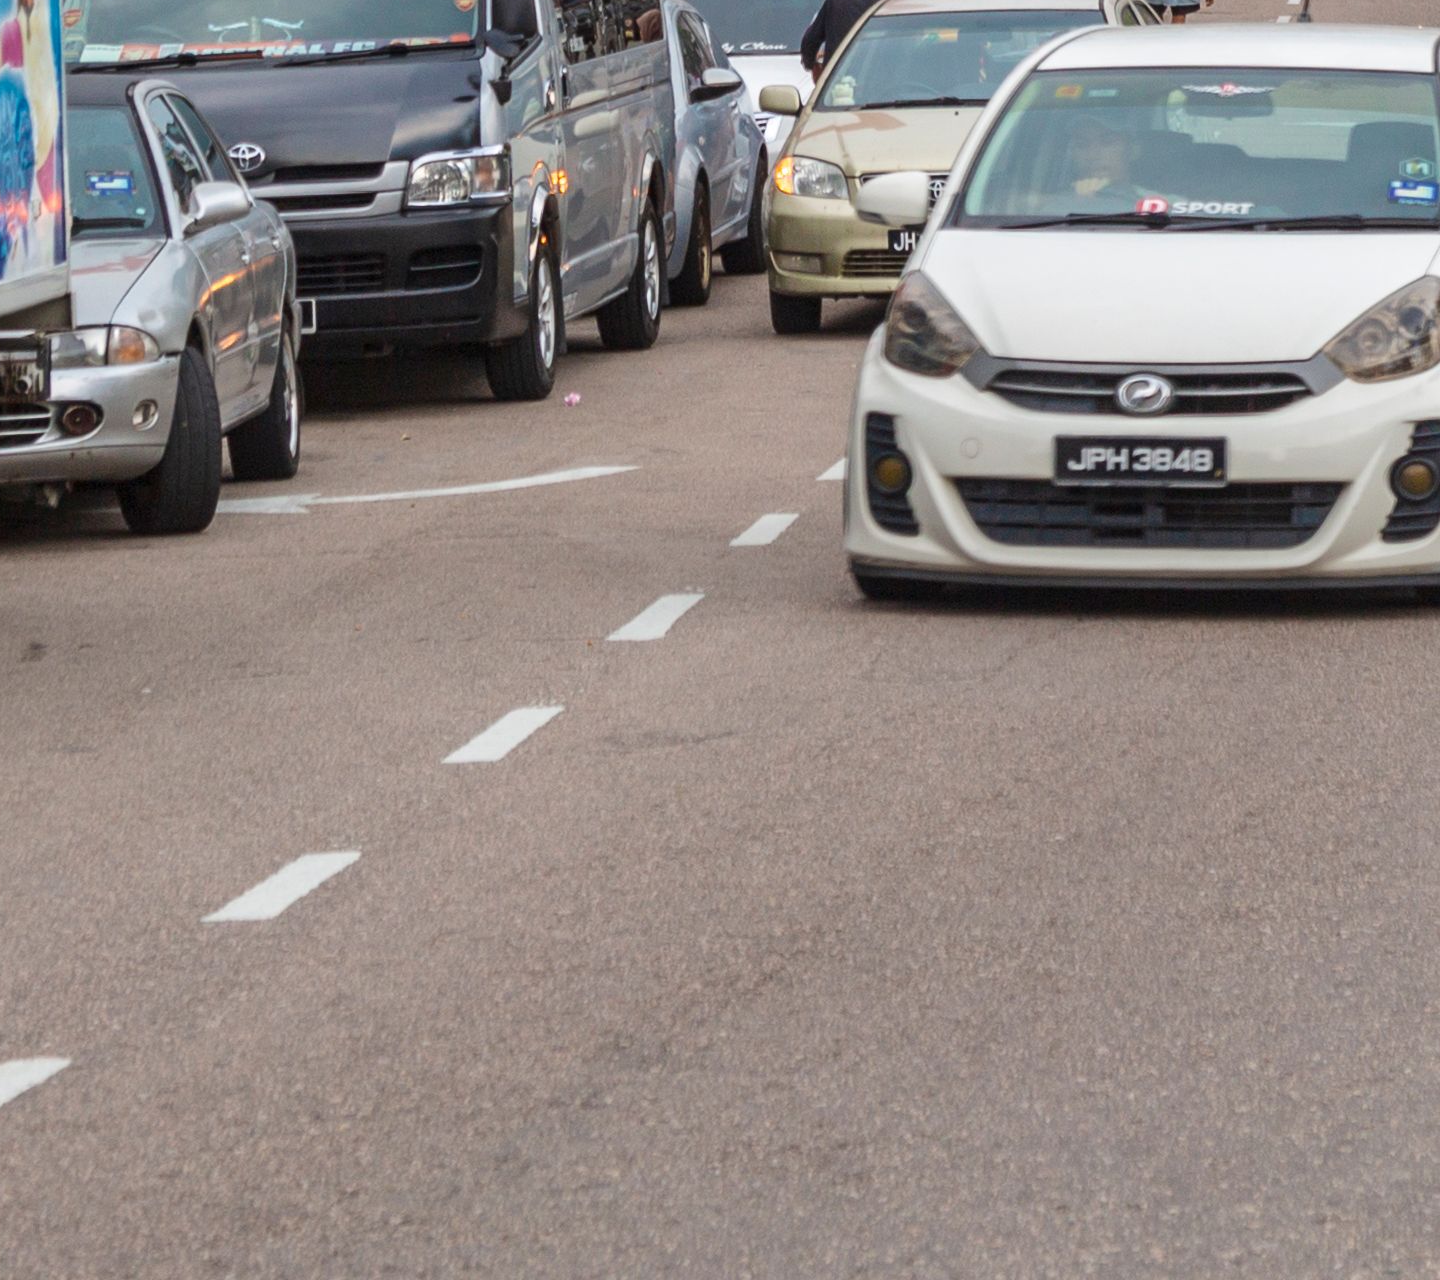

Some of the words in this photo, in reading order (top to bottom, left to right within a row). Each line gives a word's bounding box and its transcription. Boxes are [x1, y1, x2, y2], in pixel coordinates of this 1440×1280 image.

[1171, 202, 1255, 216] SPORT
[893, 232, 919, 252] JH
[1066, 447, 1130, 472] JPH
[1131, 448, 1214, 472] 3848
